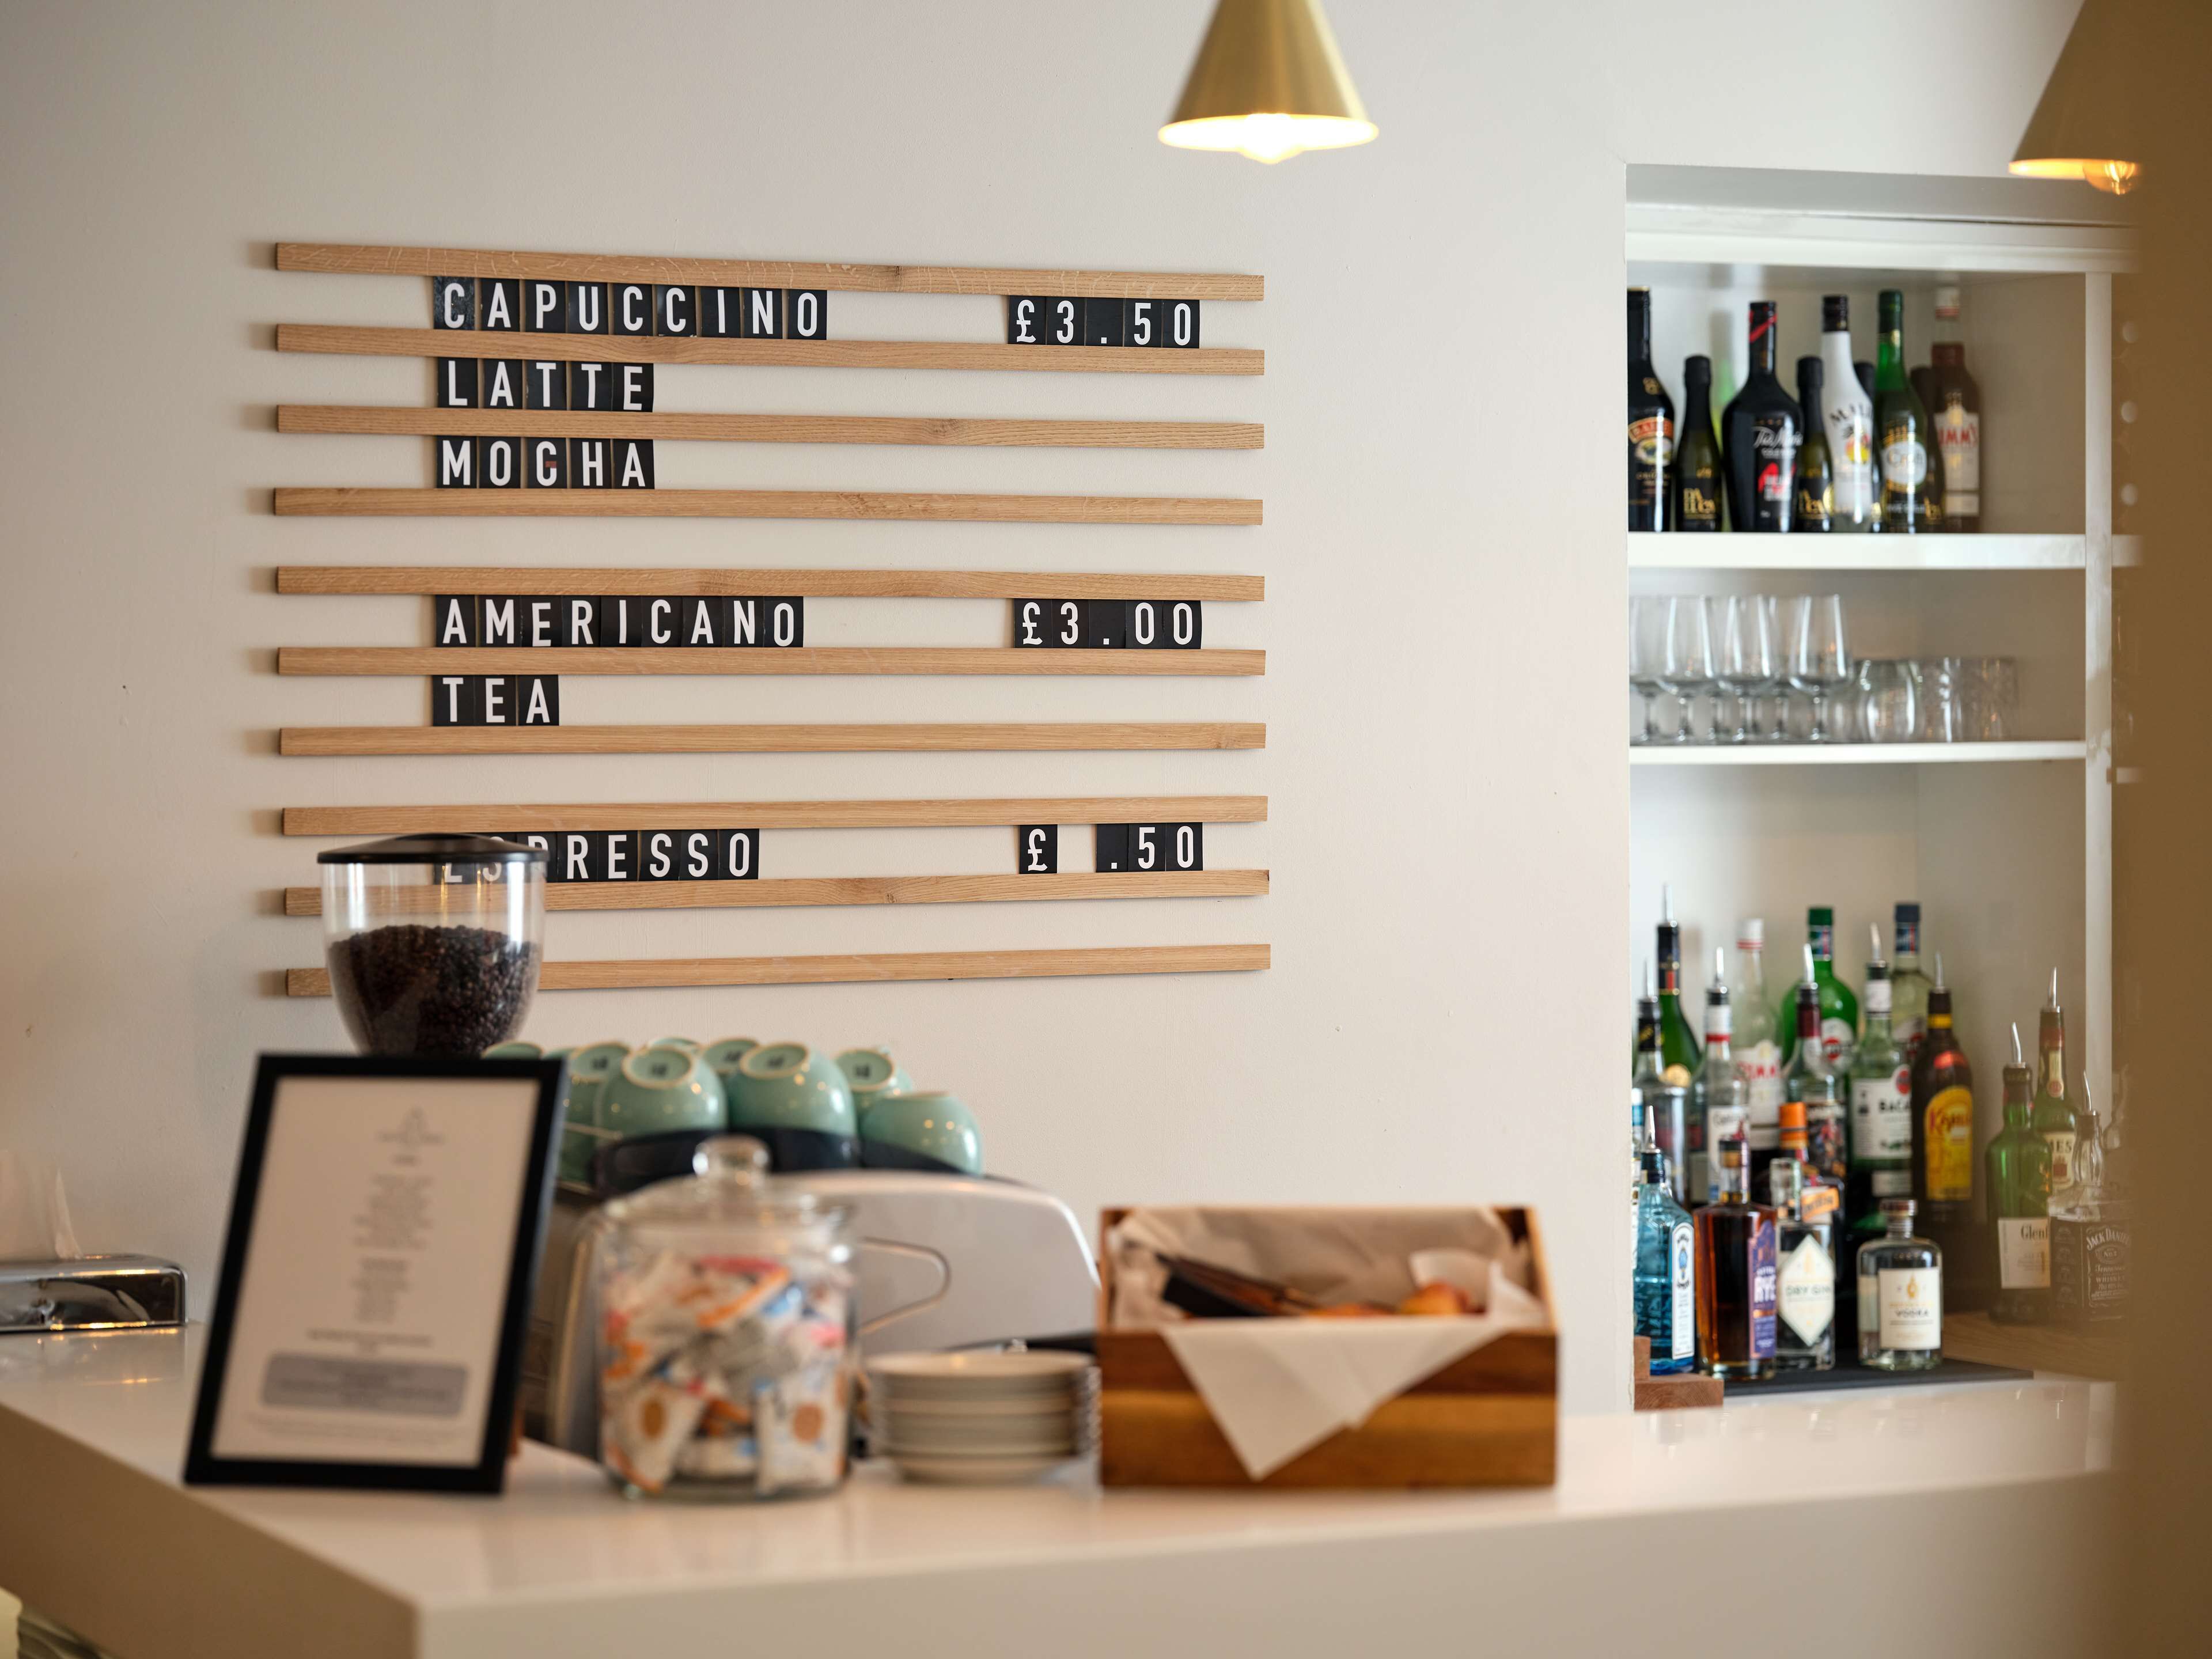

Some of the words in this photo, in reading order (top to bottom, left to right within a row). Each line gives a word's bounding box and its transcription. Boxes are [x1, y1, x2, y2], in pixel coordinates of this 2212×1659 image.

[444, 283, 817, 338] CAPUCCINO
[1016, 300, 1191, 346] £3.50
[448, 361, 643, 411] LATTE
[442, 599, 794, 647] AMERICANO
[1022, 601, 1193, 645] £3.00
[442, 677, 550, 724] TEA
